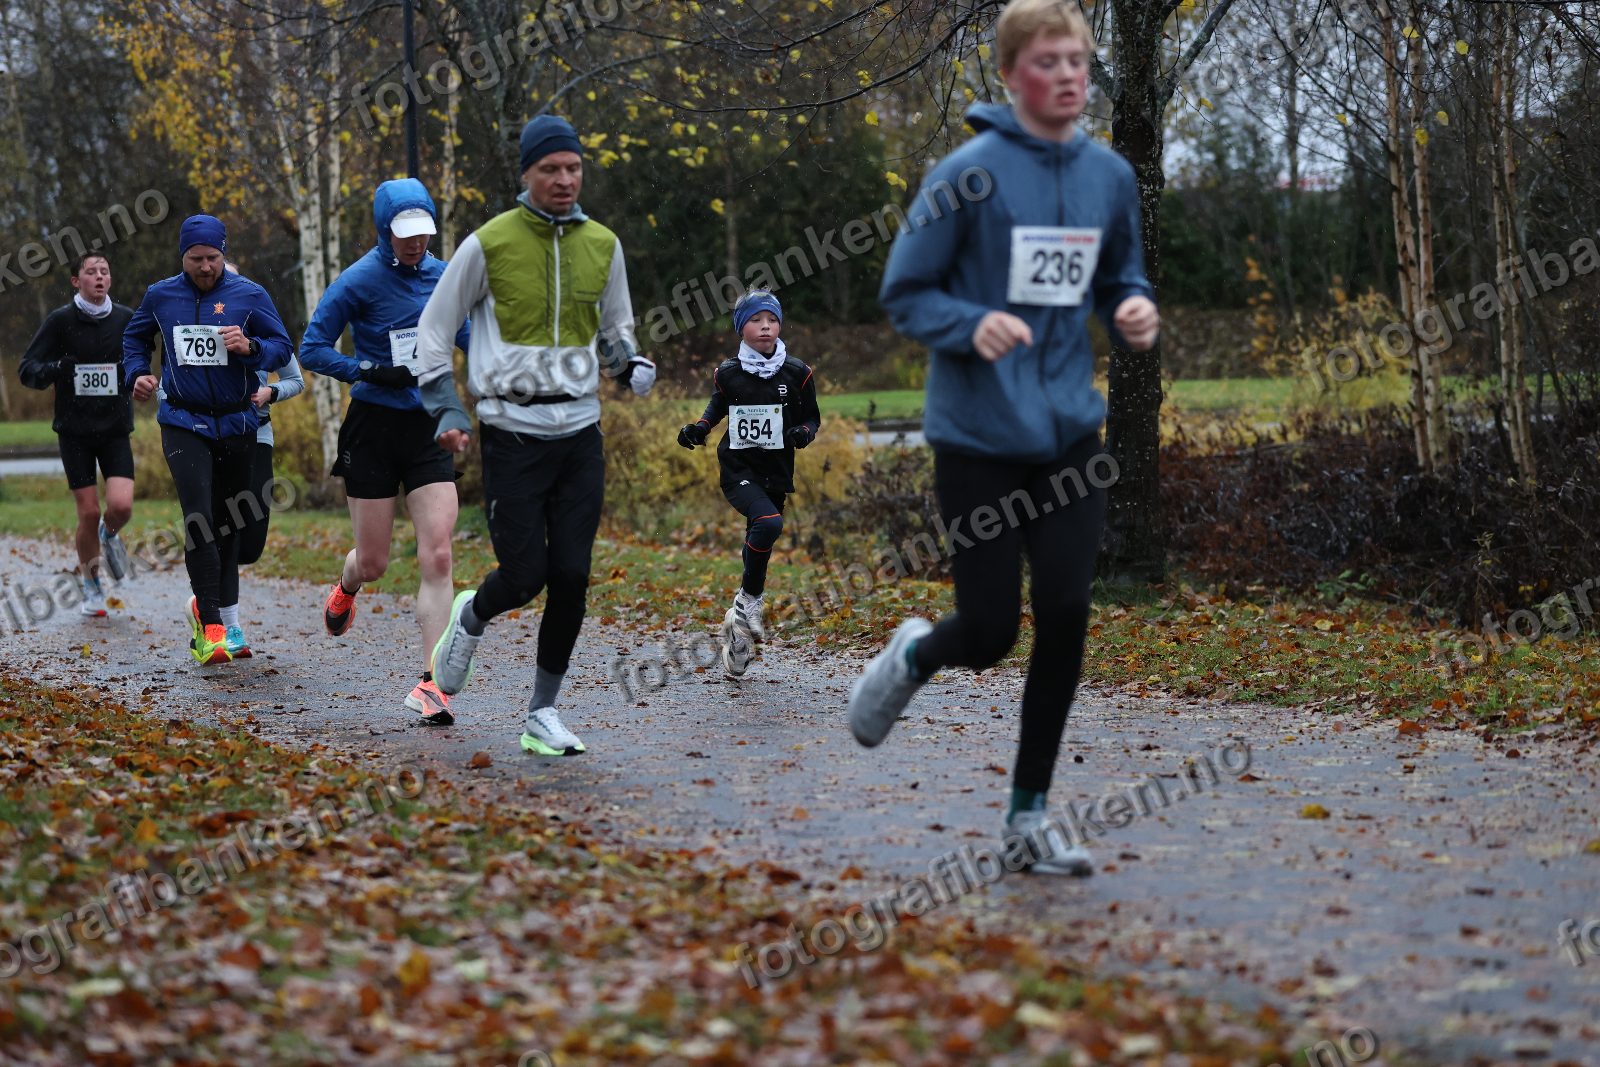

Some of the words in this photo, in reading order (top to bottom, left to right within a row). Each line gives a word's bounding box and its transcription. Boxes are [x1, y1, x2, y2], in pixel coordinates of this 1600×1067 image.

[1031, 249, 1083, 286] 236
[183, 337, 217, 357] 769
[82, 372, 108, 388] 380
[737, 418, 772, 440] 654
